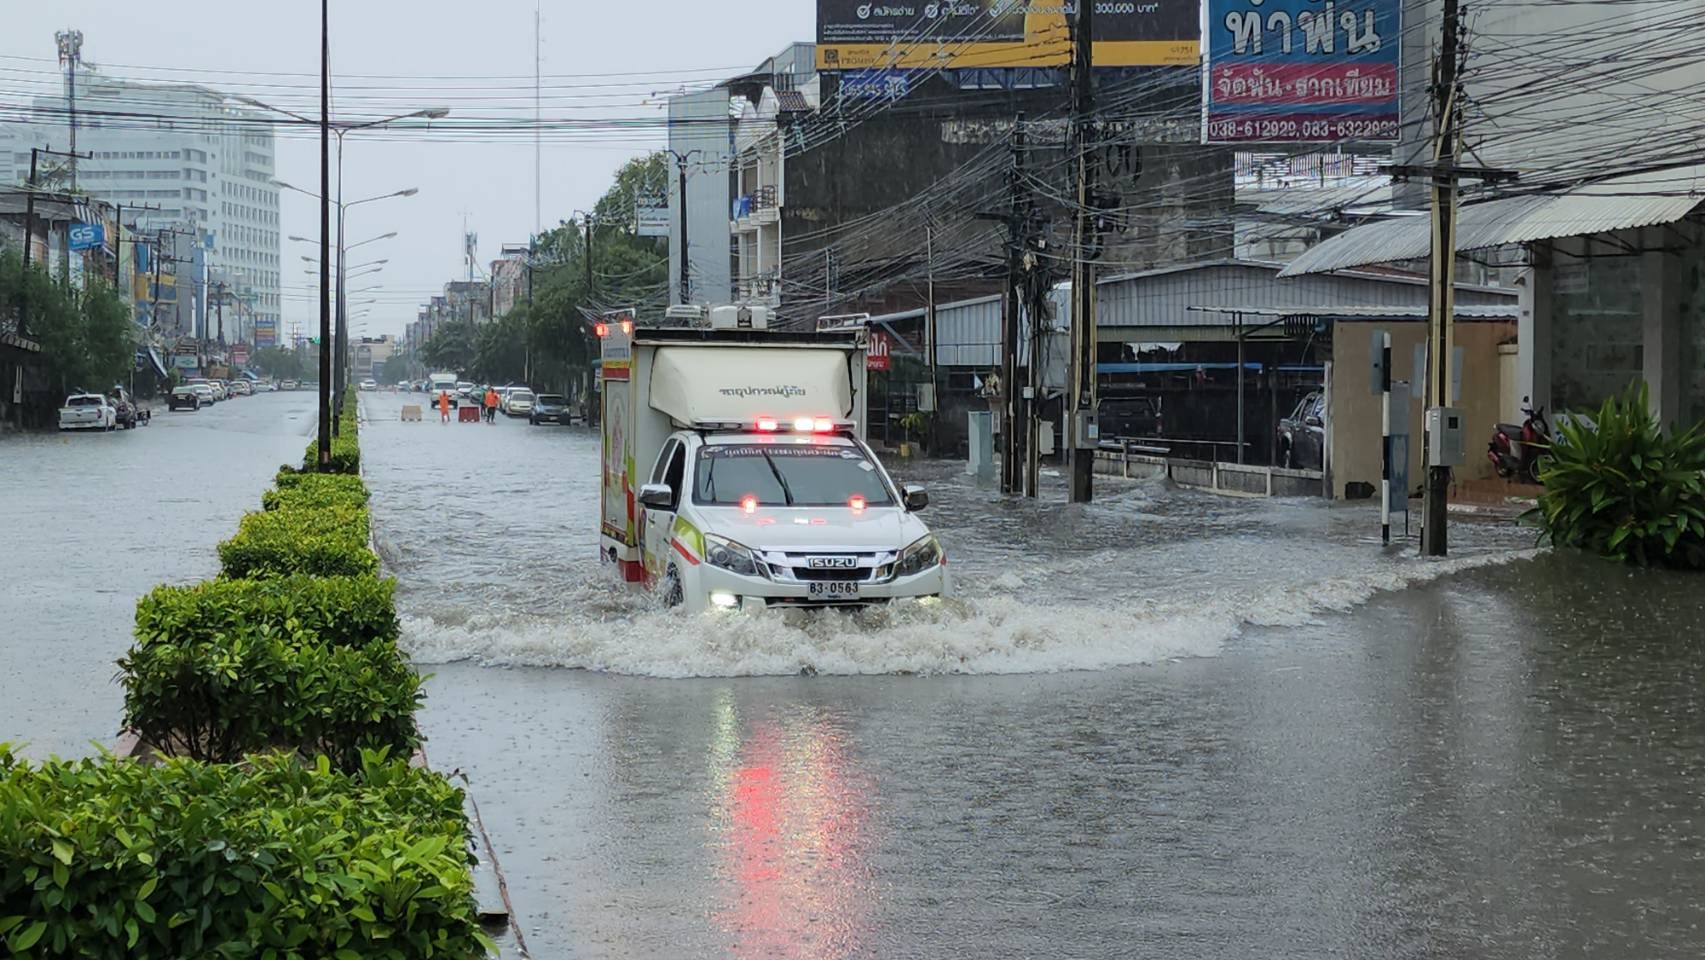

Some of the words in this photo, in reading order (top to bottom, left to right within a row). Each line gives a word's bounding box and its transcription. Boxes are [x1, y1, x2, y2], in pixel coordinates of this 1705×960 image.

[1225, 0, 1382, 54] ทำฟน
[70, 227, 94, 240] GS
[810, 558, 856, 567] ISUZU
